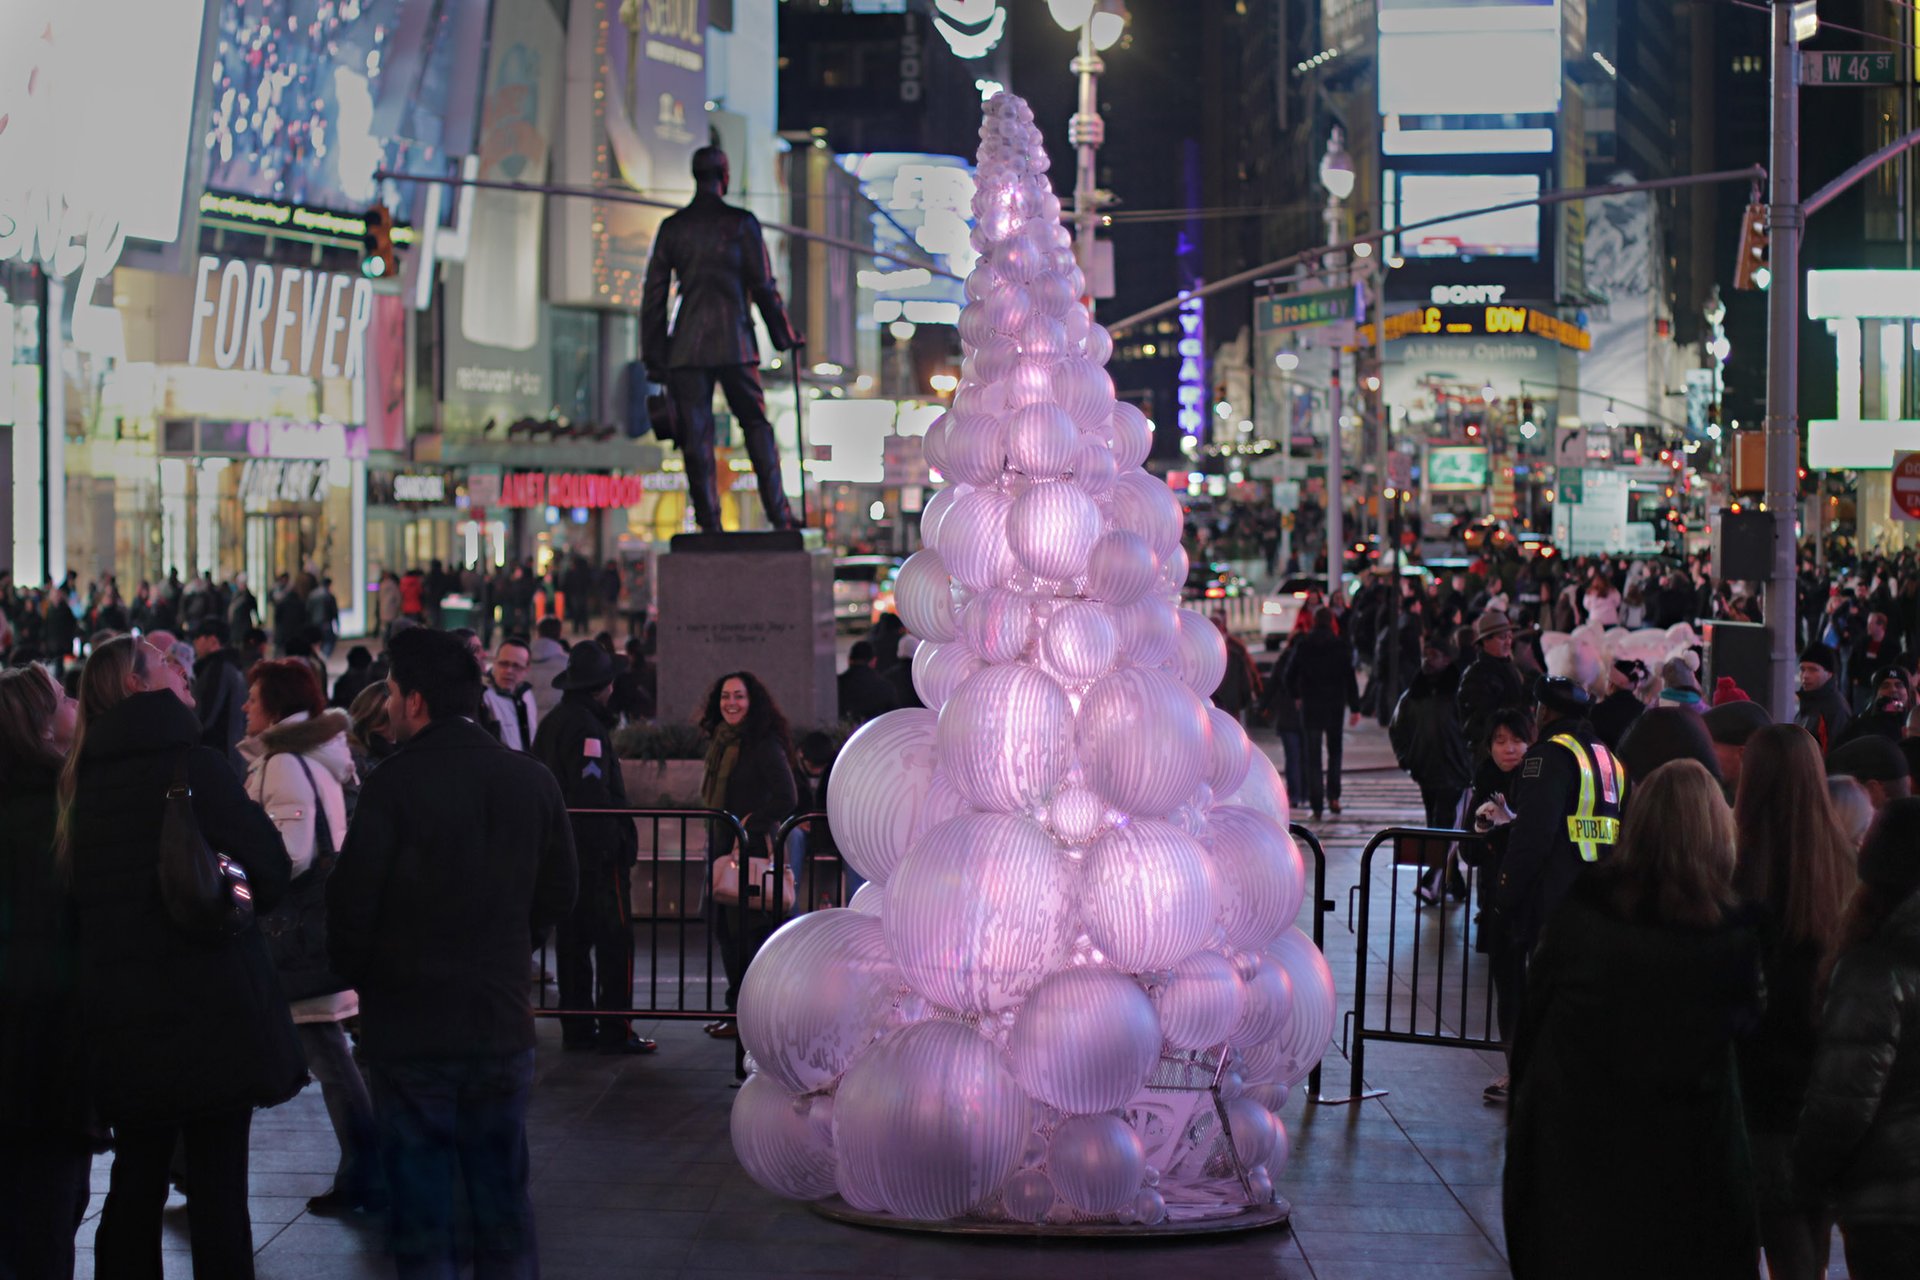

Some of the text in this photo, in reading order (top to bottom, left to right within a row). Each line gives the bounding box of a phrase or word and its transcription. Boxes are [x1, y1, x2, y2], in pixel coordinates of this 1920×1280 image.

[1827, 56, 1891, 81] W 46 ST
[1431, 285, 1506, 304] SONY
[188, 255, 373, 378] FOREVER
[1272, 298, 1347, 324] Broadway
[497, 472, 545, 507] ANET
[548, 472, 641, 508] HOLLYWOOD
